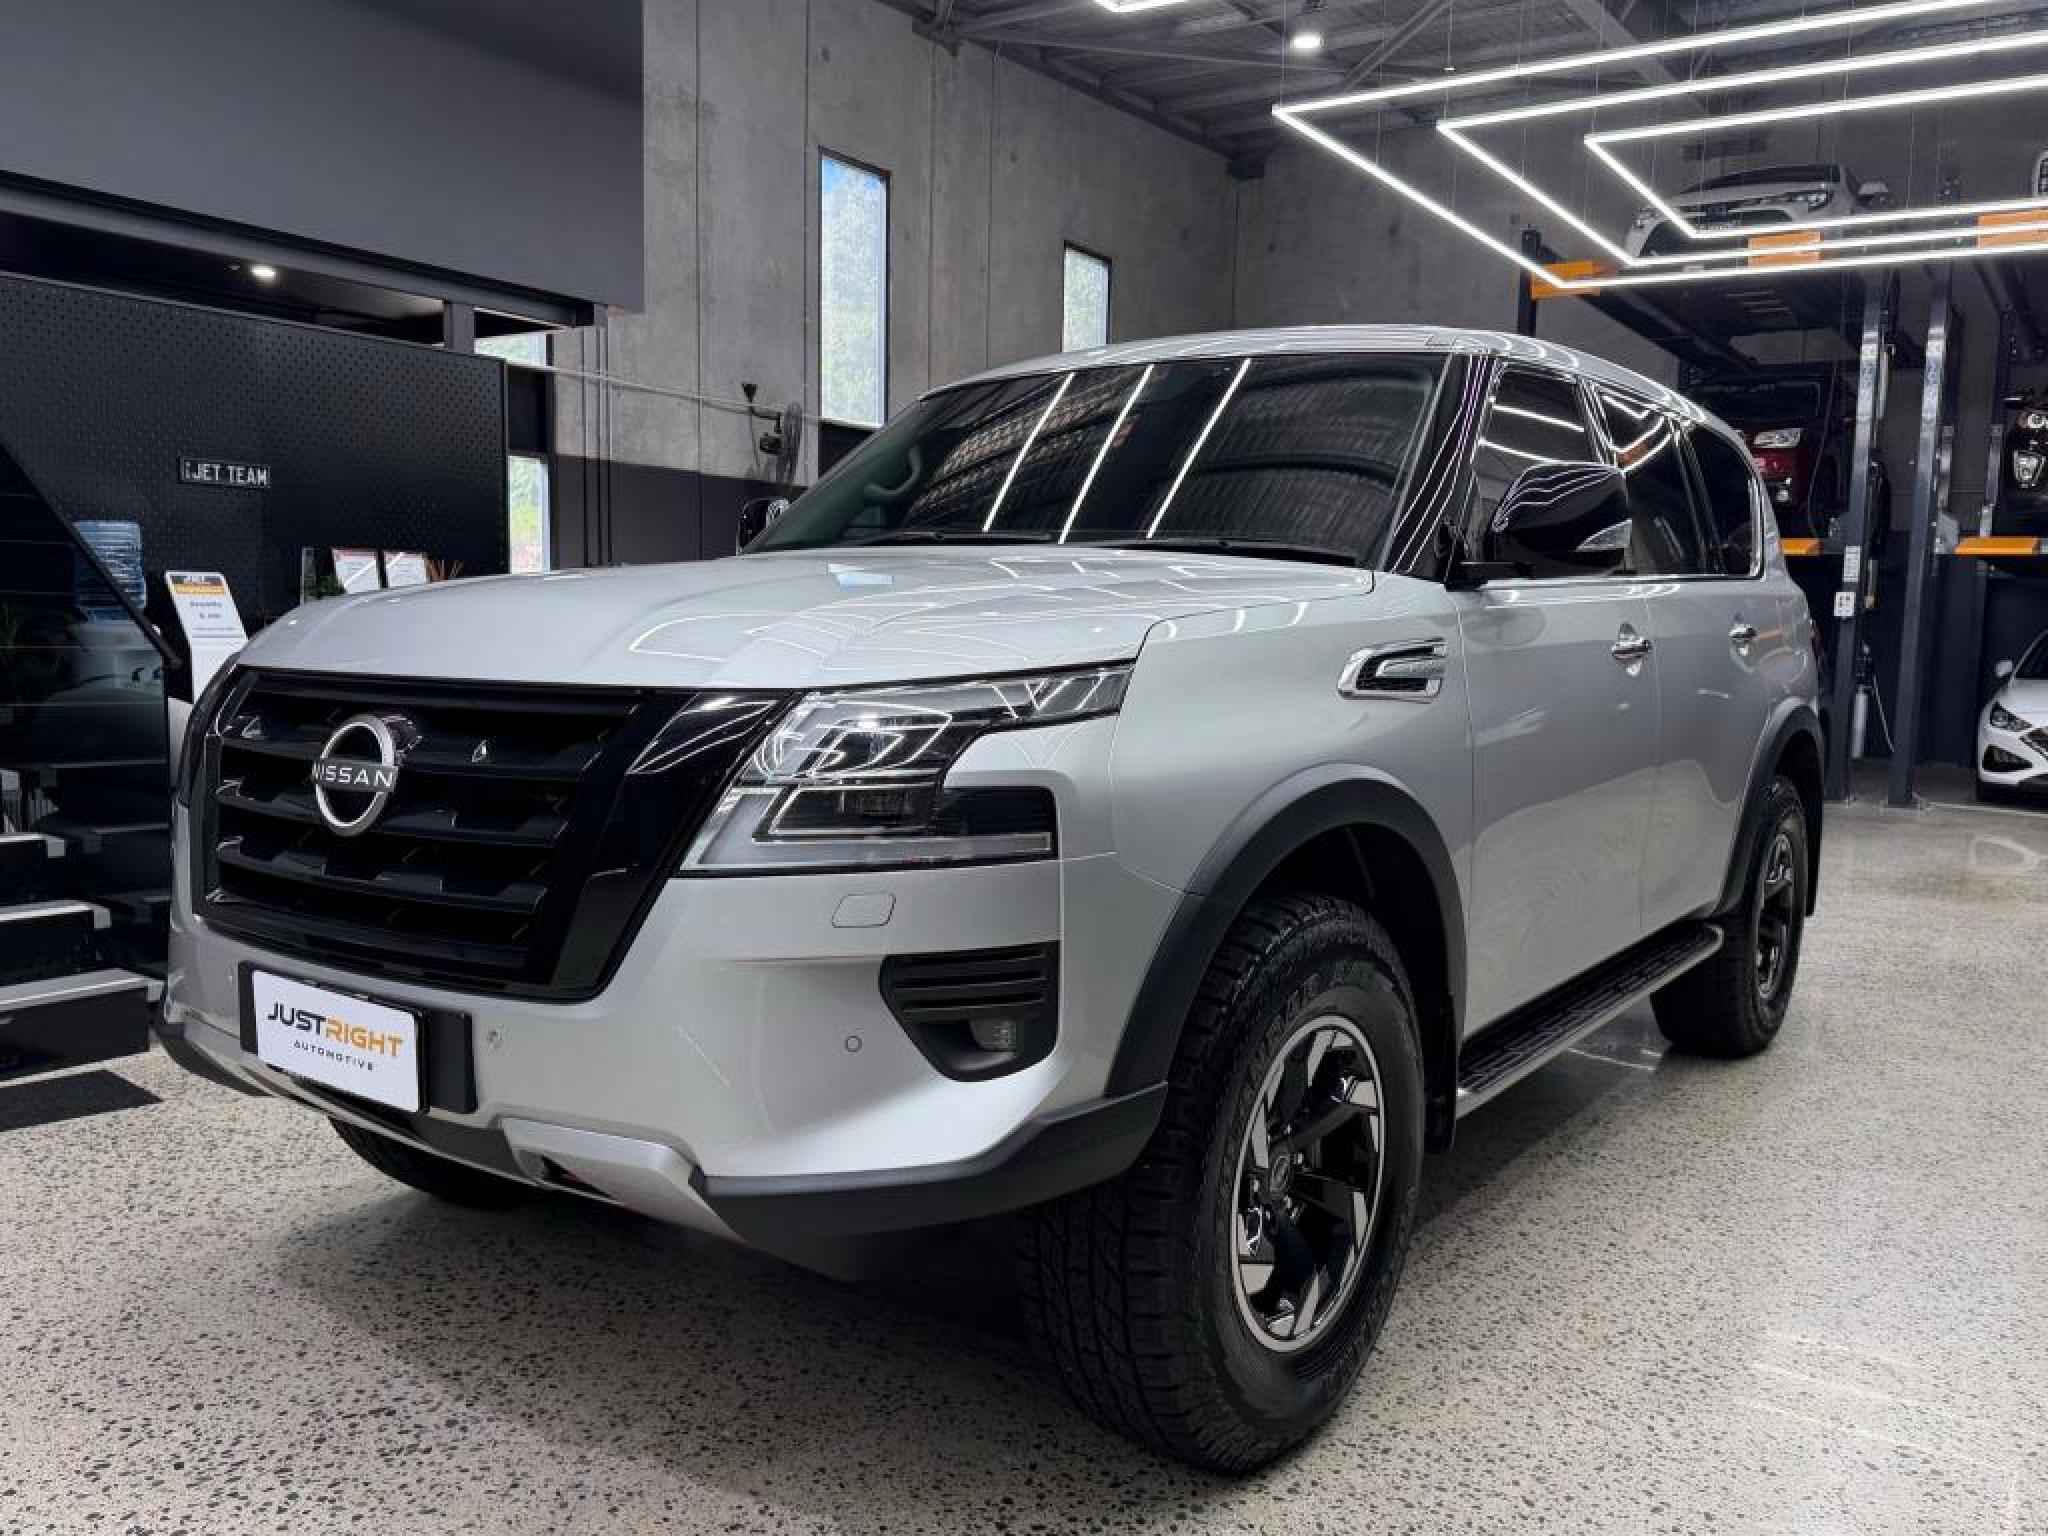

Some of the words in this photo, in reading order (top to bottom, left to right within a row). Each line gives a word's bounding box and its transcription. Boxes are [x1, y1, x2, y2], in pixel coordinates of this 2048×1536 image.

[227, 465, 267, 486] TEAM
[312, 761, 393, 788] NISSAN
[268, 1002, 404, 1057] JUSTRIGHT
[293, 1040, 374, 1071] AUTOMOTIVE
